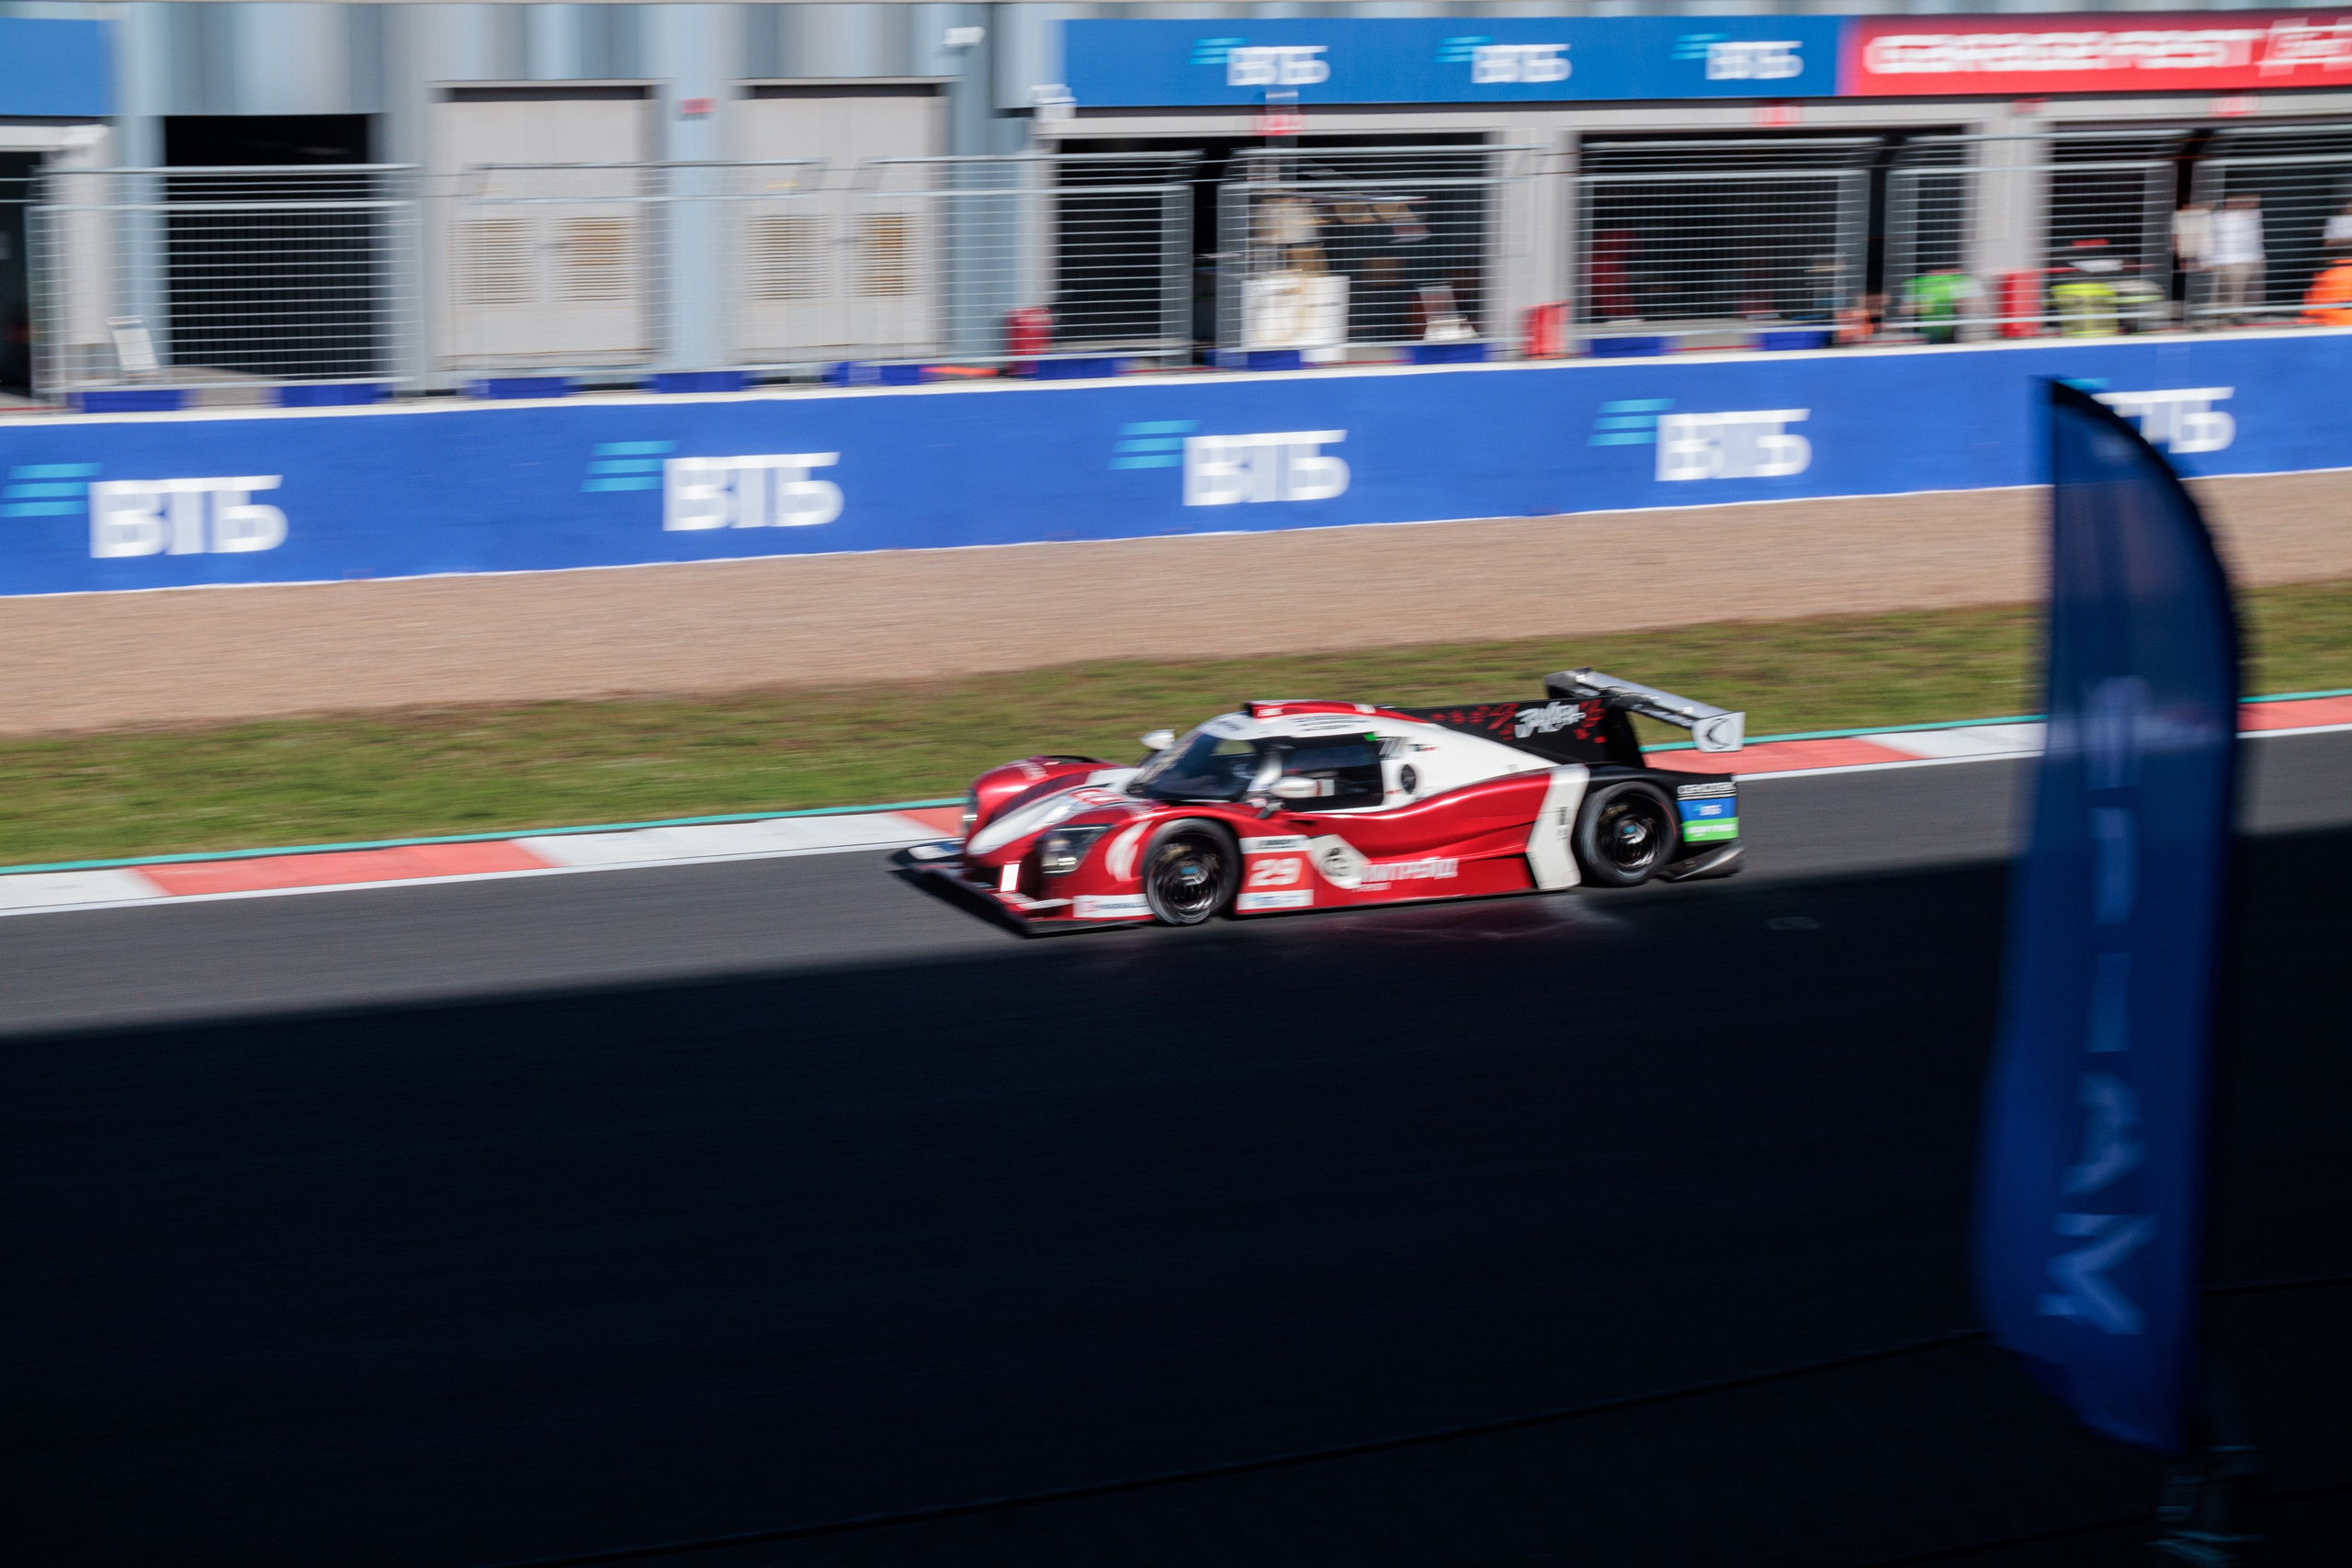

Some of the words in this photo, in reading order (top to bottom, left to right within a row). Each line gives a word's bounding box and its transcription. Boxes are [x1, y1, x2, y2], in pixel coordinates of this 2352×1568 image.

[1657, 409, 1812, 481] ВТБ
[2095, 386, 2235, 454] ТБ
[663, 451, 844, 532] ВТБ
[1184, 429, 1350, 506] ВТБ
[90, 475, 288, 558] ВТБ
